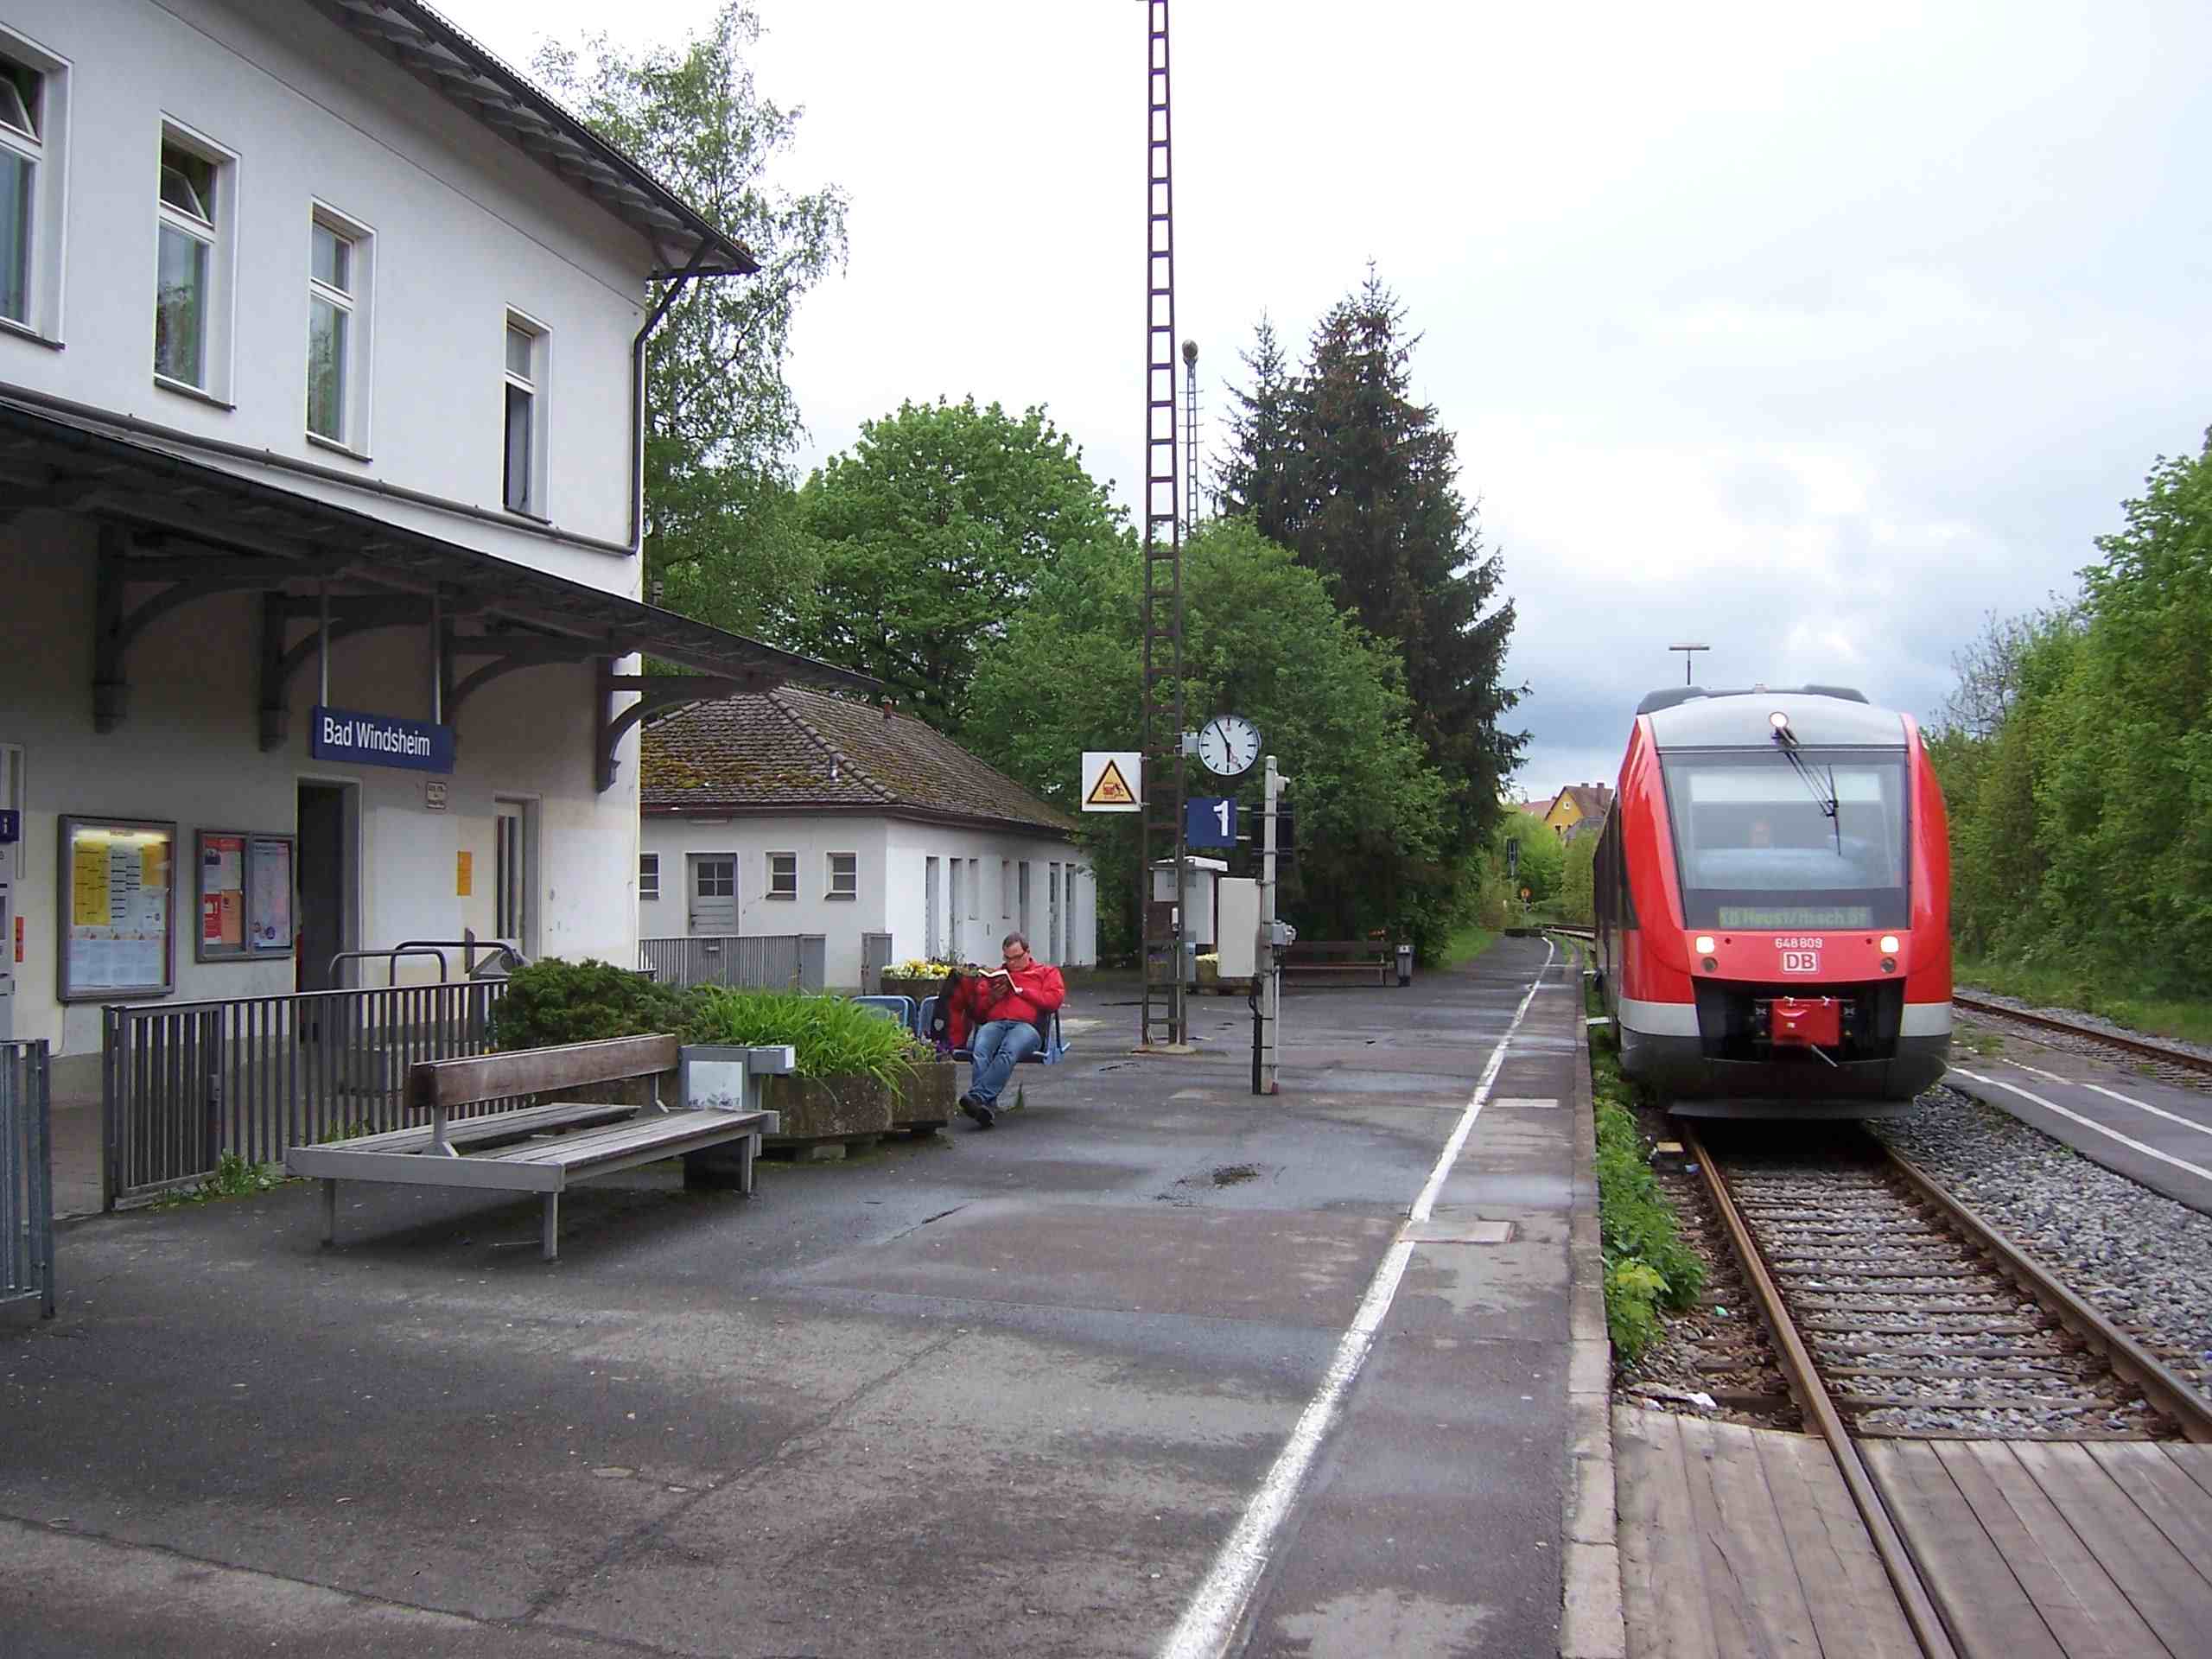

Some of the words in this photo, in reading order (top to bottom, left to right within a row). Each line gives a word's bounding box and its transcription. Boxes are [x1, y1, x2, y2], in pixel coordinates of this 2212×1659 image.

[323, 716, 353, 747] Bad
[356, 721, 430, 756] Windsheim
[1213, 800, 1229, 836] 1
[1786, 953, 1815, 969] DB
